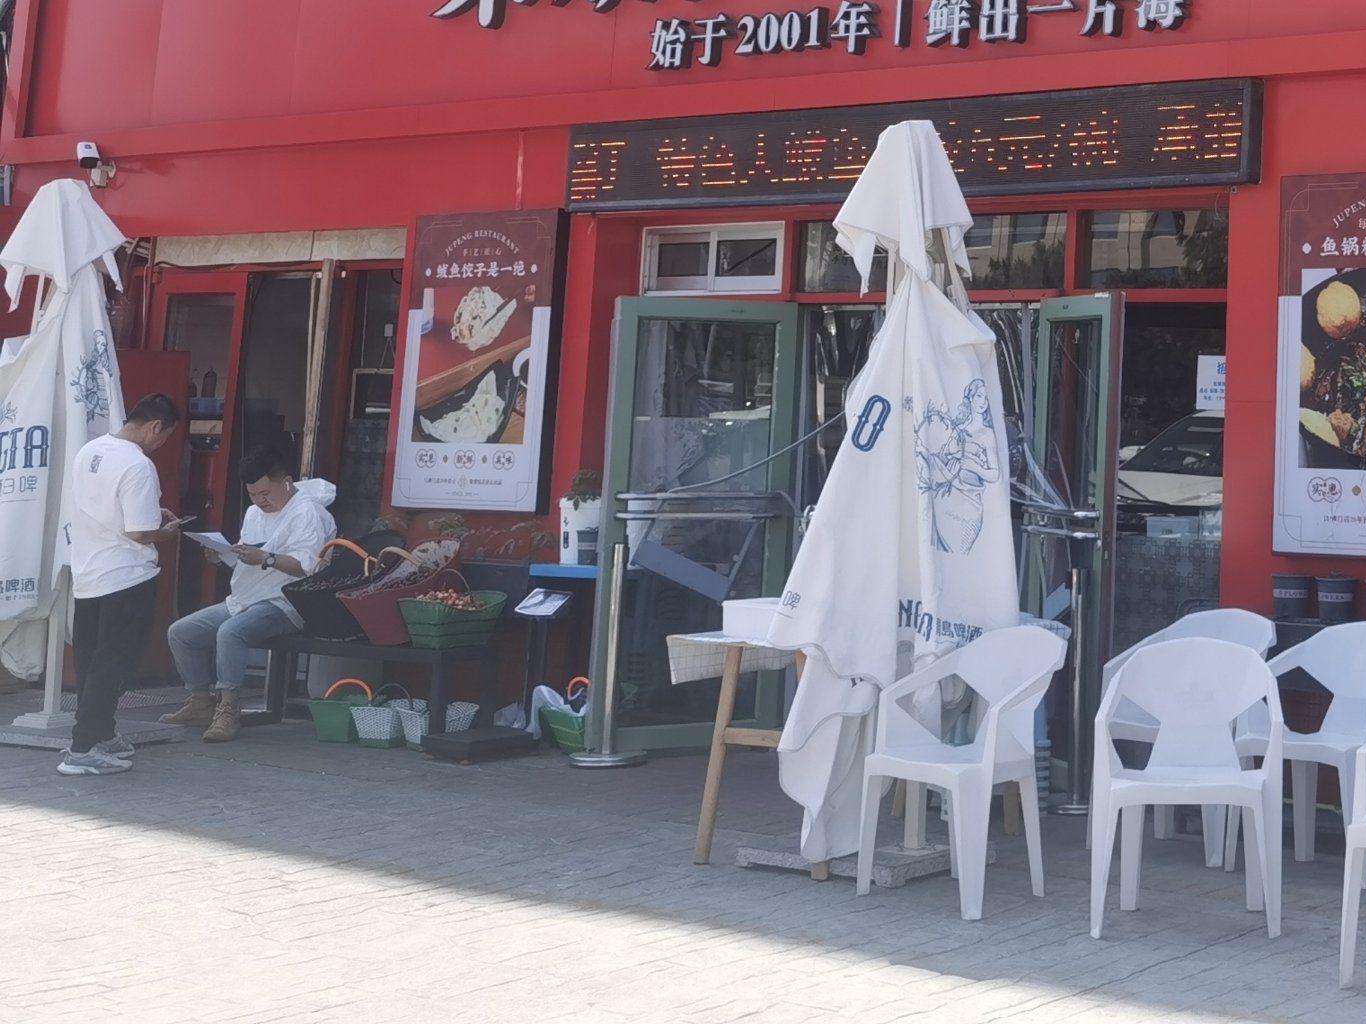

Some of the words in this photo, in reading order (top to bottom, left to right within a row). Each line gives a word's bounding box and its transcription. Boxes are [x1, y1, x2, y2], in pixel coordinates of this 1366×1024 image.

[436, 260, 526, 278] 鲅鱼饺子是一绝
[1312, 481, 1338, 497] 实惠
